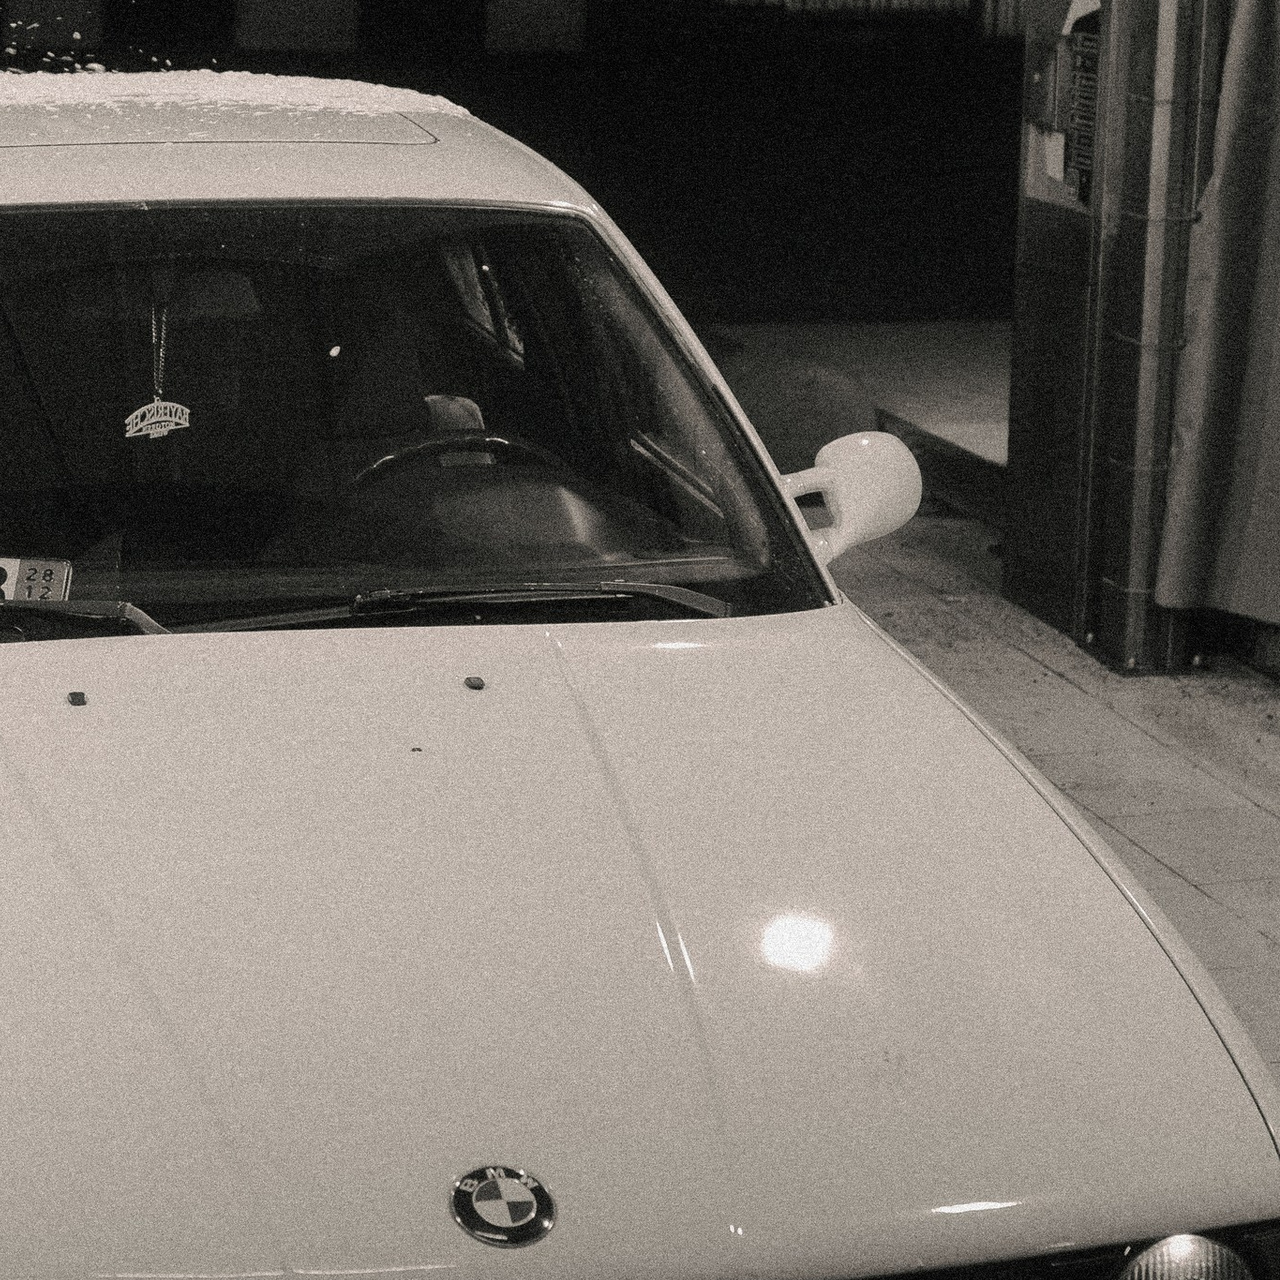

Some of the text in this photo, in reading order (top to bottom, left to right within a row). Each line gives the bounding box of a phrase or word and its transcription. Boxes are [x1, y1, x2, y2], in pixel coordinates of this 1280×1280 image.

[25, 567, 54, 582] 28
[26, 585, 52, 600] 12
[459, 1167, 540, 1193] BMW
